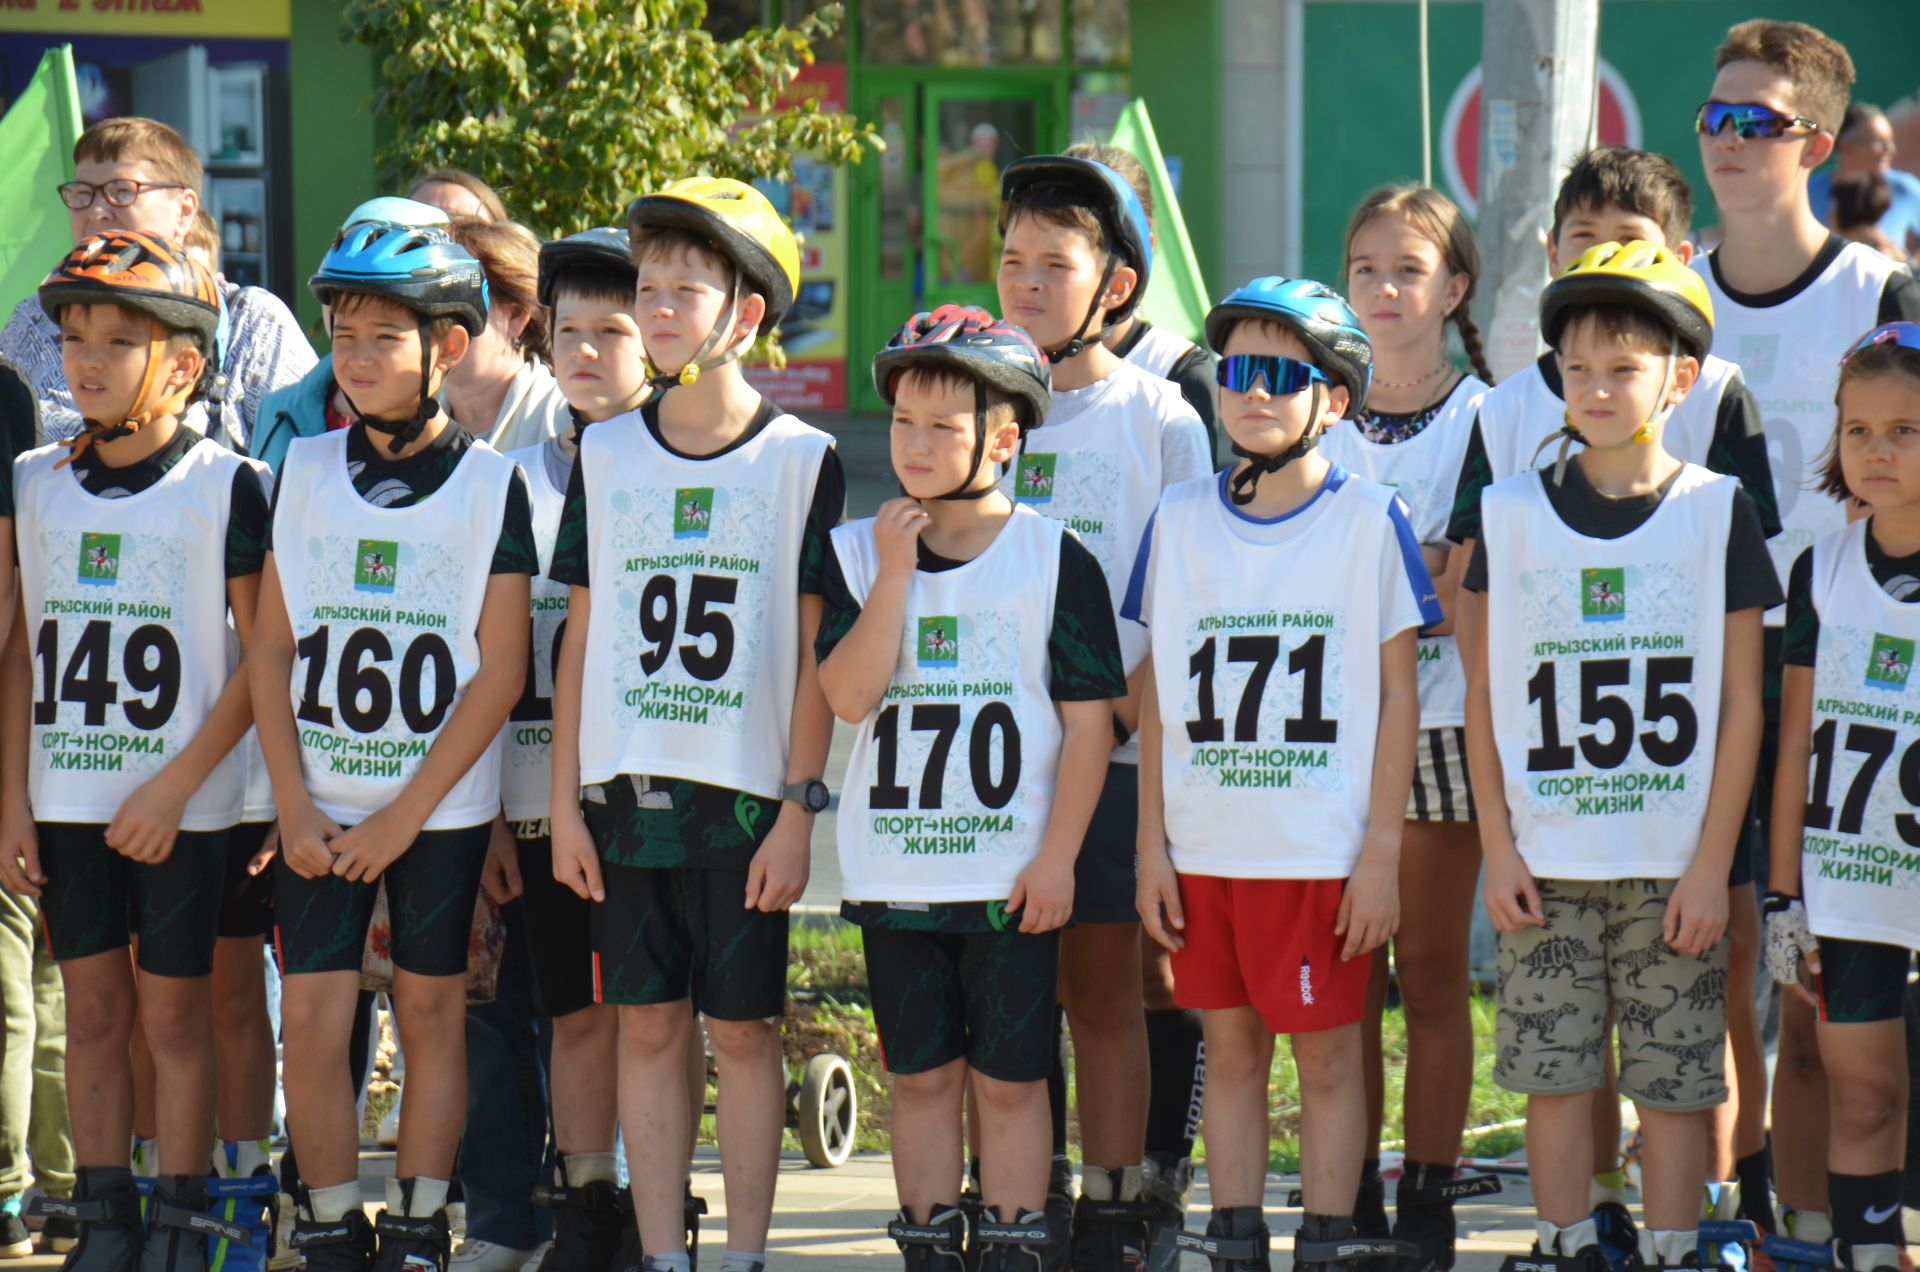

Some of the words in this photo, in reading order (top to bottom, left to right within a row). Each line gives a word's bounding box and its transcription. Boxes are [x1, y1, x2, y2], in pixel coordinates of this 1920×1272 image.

[709, 553, 760, 574] РАЙОН
[43, 597, 113, 615] ГРЫЗСКИЙ
[117, 599, 171, 619] РАЙОН
[313, 605, 391, 623] АГРЫЗСКИЙ
[396, 608, 447, 628] РАЙОН
[639, 573, 739, 682] 95
[1198, 610, 1277, 631] АГРЫЗСКИЙ
[1282, 610, 1334, 628] РАЙОН
[1534, 633, 1626, 656] АГРЫЗСКИЙ
[1631, 631, 1684, 650] РАЙОН
[35, 619, 181, 730] 149
[297, 625, 457, 733] 160
[673, 684, 743, 709] НОРМА
[963, 678, 1013, 697] РАЙОН
[1185, 634, 1338, 743] 171
[637, 701, 709, 725] ЖИЗНИ
[1527, 656, 1698, 772] 155
[1816, 698, 1900, 722] АГРЫЗСКИЙ
[86, 733, 165, 754] НОРМА
[302, 728, 350, 754] СПОРТ
[366, 739, 428, 758] НОРМ
[49, 751, 123, 771] ЖИЗНИ
[329, 755, 402, 777] ЖИЗНИ
[869, 701, 1022, 809] 170
[1255, 749, 1328, 768] НОРМА
[1219, 769, 1292, 788] ЖИЗНИ
[1538, 776, 1594, 796] СПОРТ
[1612, 772, 1686, 793] НОРМА
[1575, 793, 1644, 815] ЖИЗНИ
[516, 818, 551, 839] ZEA
[874, 816, 925, 834] СПОРТ
[941, 815, 1014, 834] НОРМА
[902, 836, 976, 855] ЖИЗНИ
[1857, 842, 1920, 873] НОРМ
[1819, 859, 1892, 887] ЖИЗНИ
[1301, 966, 1314, 1006] Reebok
[1441, 1183, 1481, 1197] TISA
[190, 1216, 241, 1240] SPINE
[978, 1229, 1026, 1238] SPINE
[1176, 1235, 1218, 1253] SPINE
[1337, 1244, 1397, 1256] SPINE
